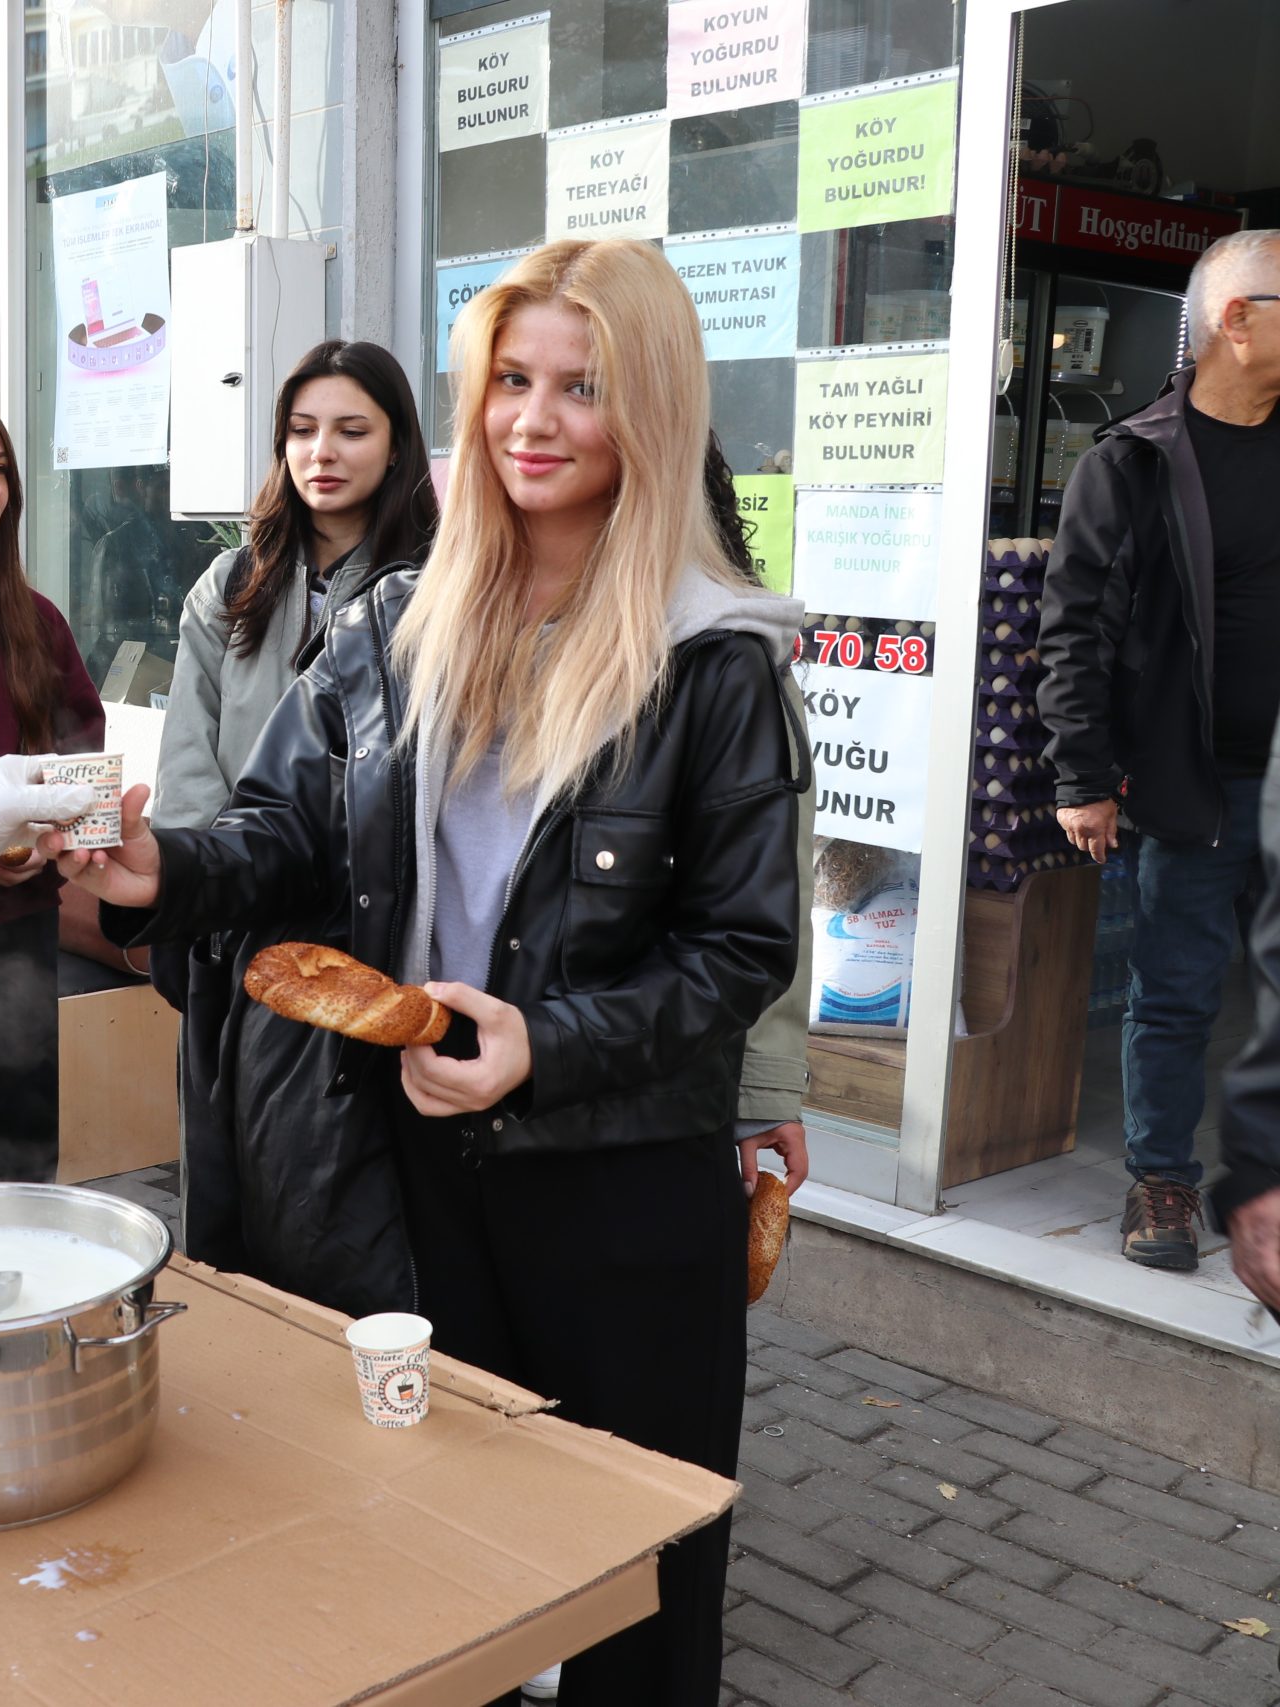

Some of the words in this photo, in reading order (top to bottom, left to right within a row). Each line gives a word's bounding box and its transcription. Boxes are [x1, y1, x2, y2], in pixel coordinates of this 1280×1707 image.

[690, 35, 780, 66] YOĞURDU
[477, 51, 510, 73] KÖY
[457, 75, 530, 104] BULGURU
[690, 68, 778, 98] BULUNUR
[457, 103, 530, 131] BULUNUR
[855, 117, 897, 139] KÖY
[589, 149, 625, 170] KÖY
[827, 144, 925, 172] YOĞURDU
[566, 174, 649, 201] TEREYAĞI
[824, 174, 926, 203] BULUNUR!
[566, 204, 647, 230] BULUNUR
[677, 262, 727, 279] GEZEN
[732, 256, 787, 274] TAVUK
[702, 315, 767, 331] ULUNUR
[820, 382, 859, 398] TAM
[865, 376, 923, 396] YAĞLI
[808, 412, 847, 430] KÖY
[854, 407, 932, 428] PEYNİRİ
[822, 444, 915, 460] BULUNUR
[826, 505, 880, 519] MANDA
[807, 529, 858, 548] KARIŞIK
[834, 557, 901, 573] BULUNUR
[814, 630, 863, 668] 70
[874, 634, 927, 673] 58
[801, 688, 861, 719] KÖY
[59, 764, 105, 778] Coffee
[81, 826, 107, 835] Tea
[874, 920, 896, 929] TUZ
[376, 1418, 406, 1429] Coffee
